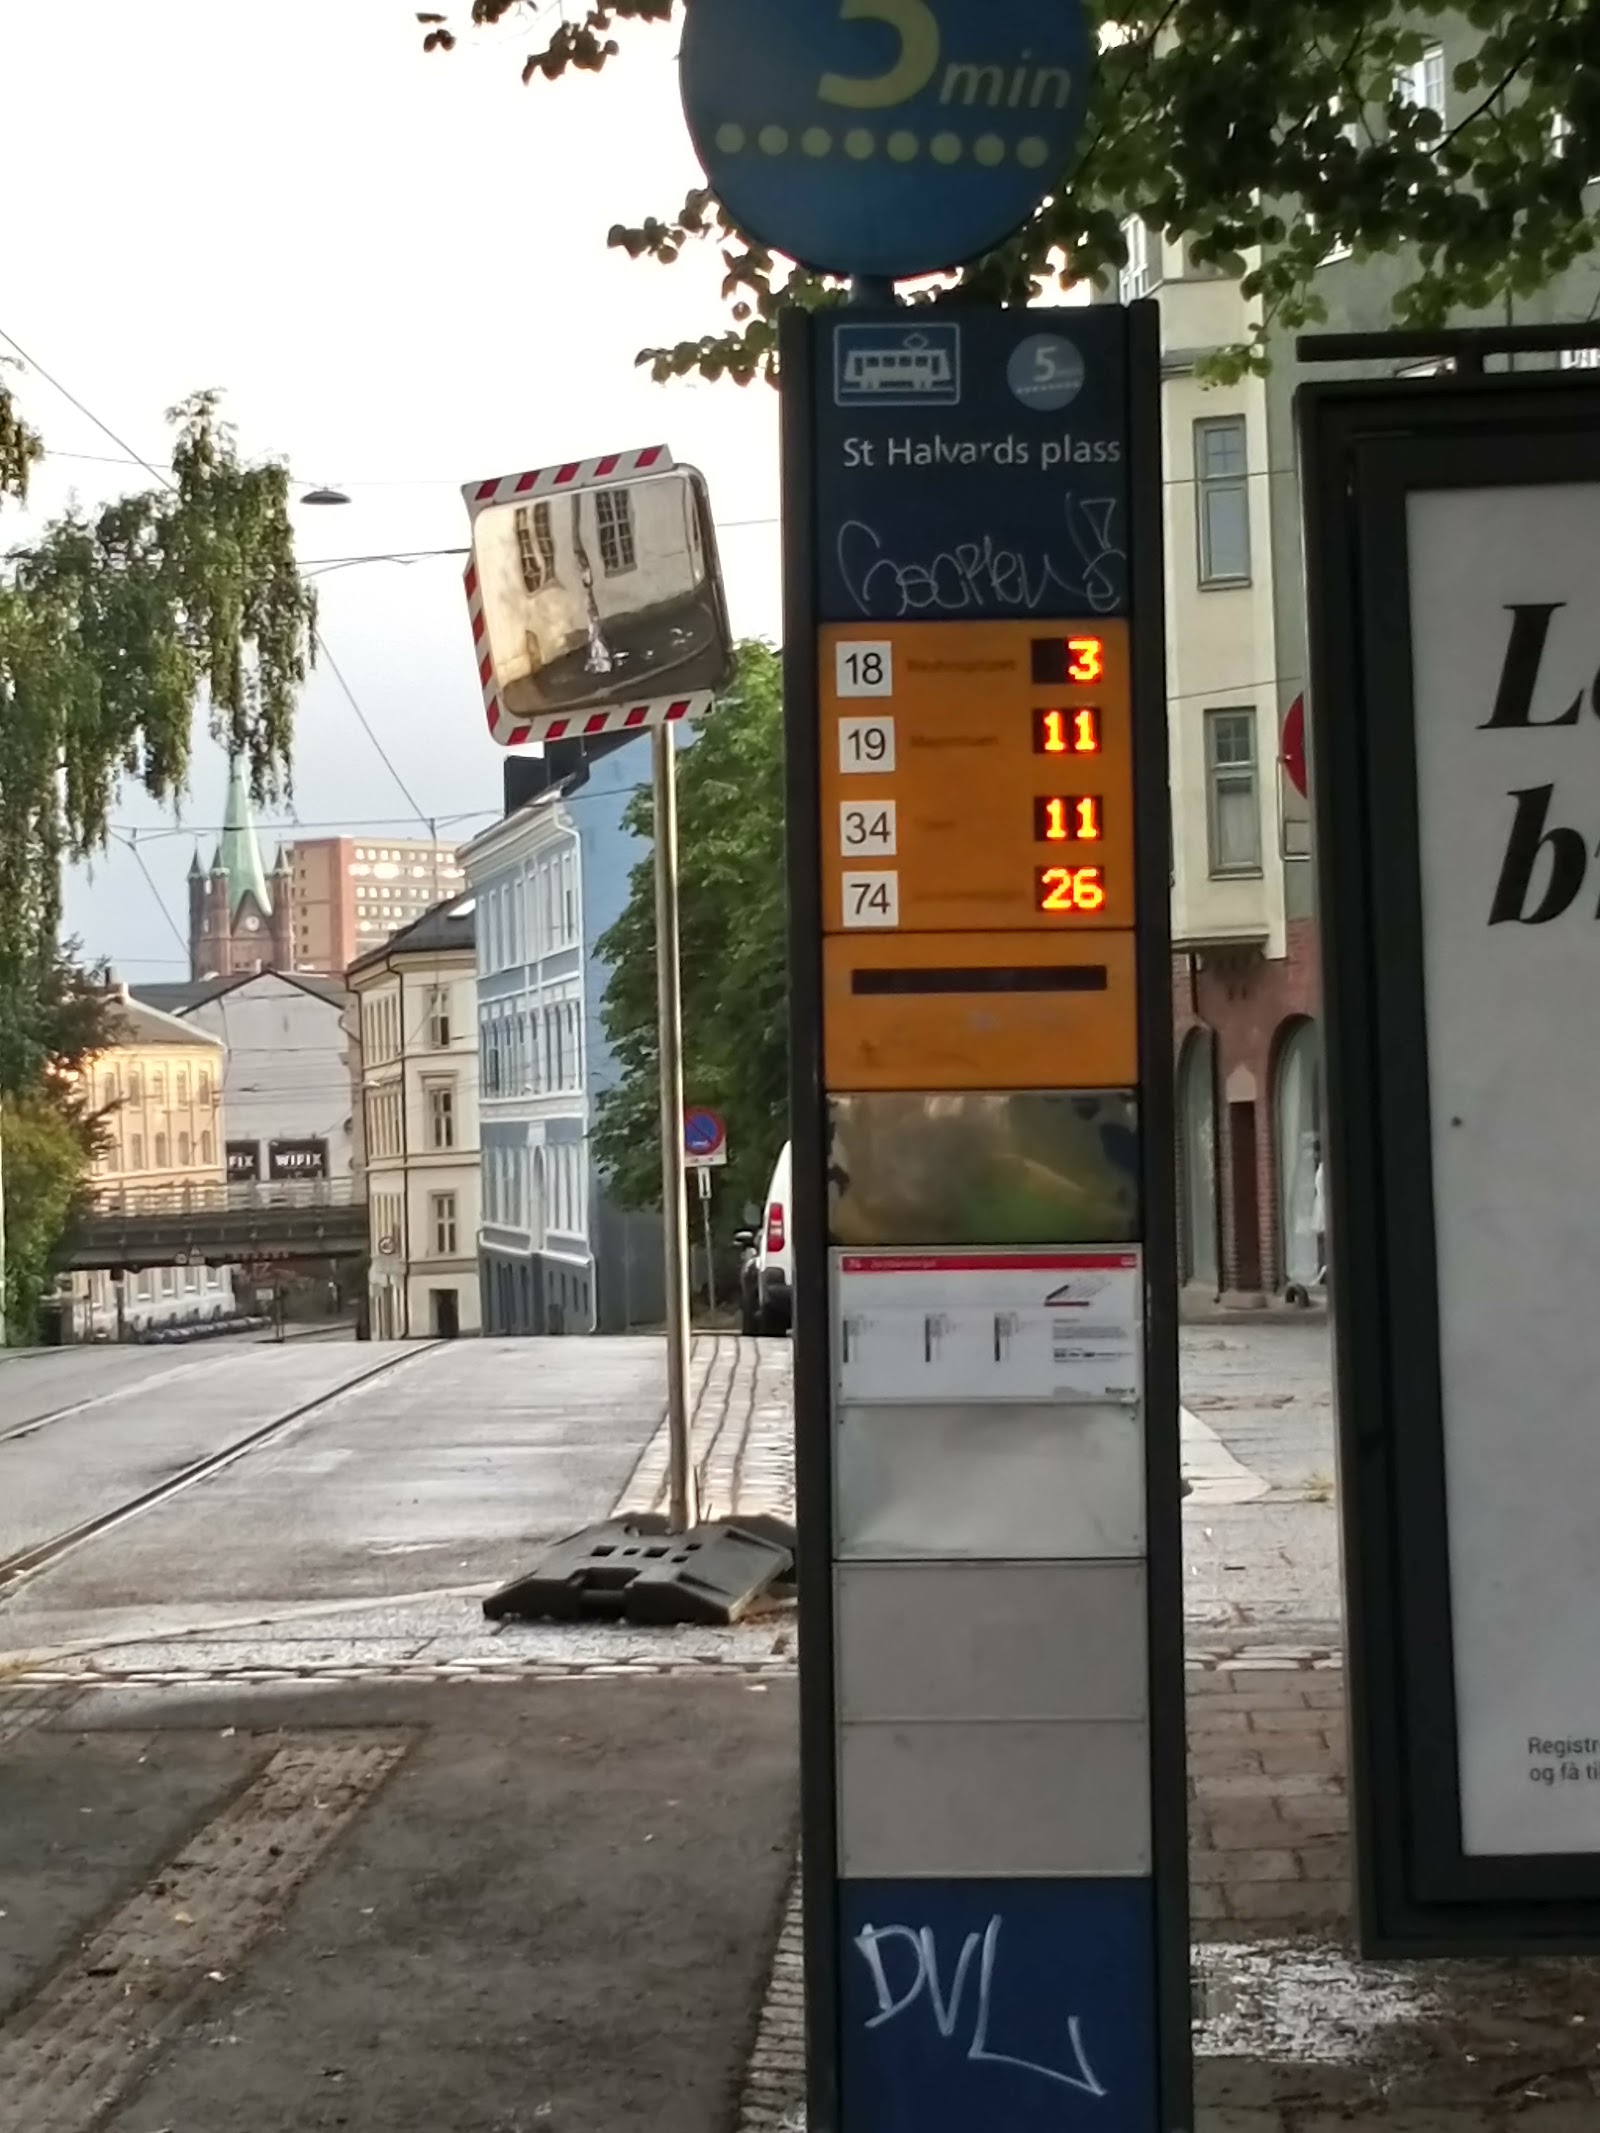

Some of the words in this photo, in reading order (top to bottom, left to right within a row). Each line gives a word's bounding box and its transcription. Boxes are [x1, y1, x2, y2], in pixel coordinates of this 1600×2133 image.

[940, 50, 1071, 109] min
[1033, 346, 1057, 382] 5
[843, 437, 875, 467] St
[887, 434, 1030, 465] Halvards
[1040, 434, 1121, 470] plass
[845, 653, 884, 686] 18
[1068, 639, 1102, 681] 3
[1476, 602, 1600, 730] L
[848, 728, 886, 760] 19
[1043, 710, 1097, 752] 11
[845, 812, 891, 844] 34
[1045, 797, 1098, 840] 11
[1488, 783, 1600, 926] b
[850, 883, 891, 914] 74
[1041, 867, 1104, 910] 26
[1528, 1735, 1600, 1758] Registr
[1529, 1766, 1555, 1786] og
[1560, 1761, 1580, 1781] få
